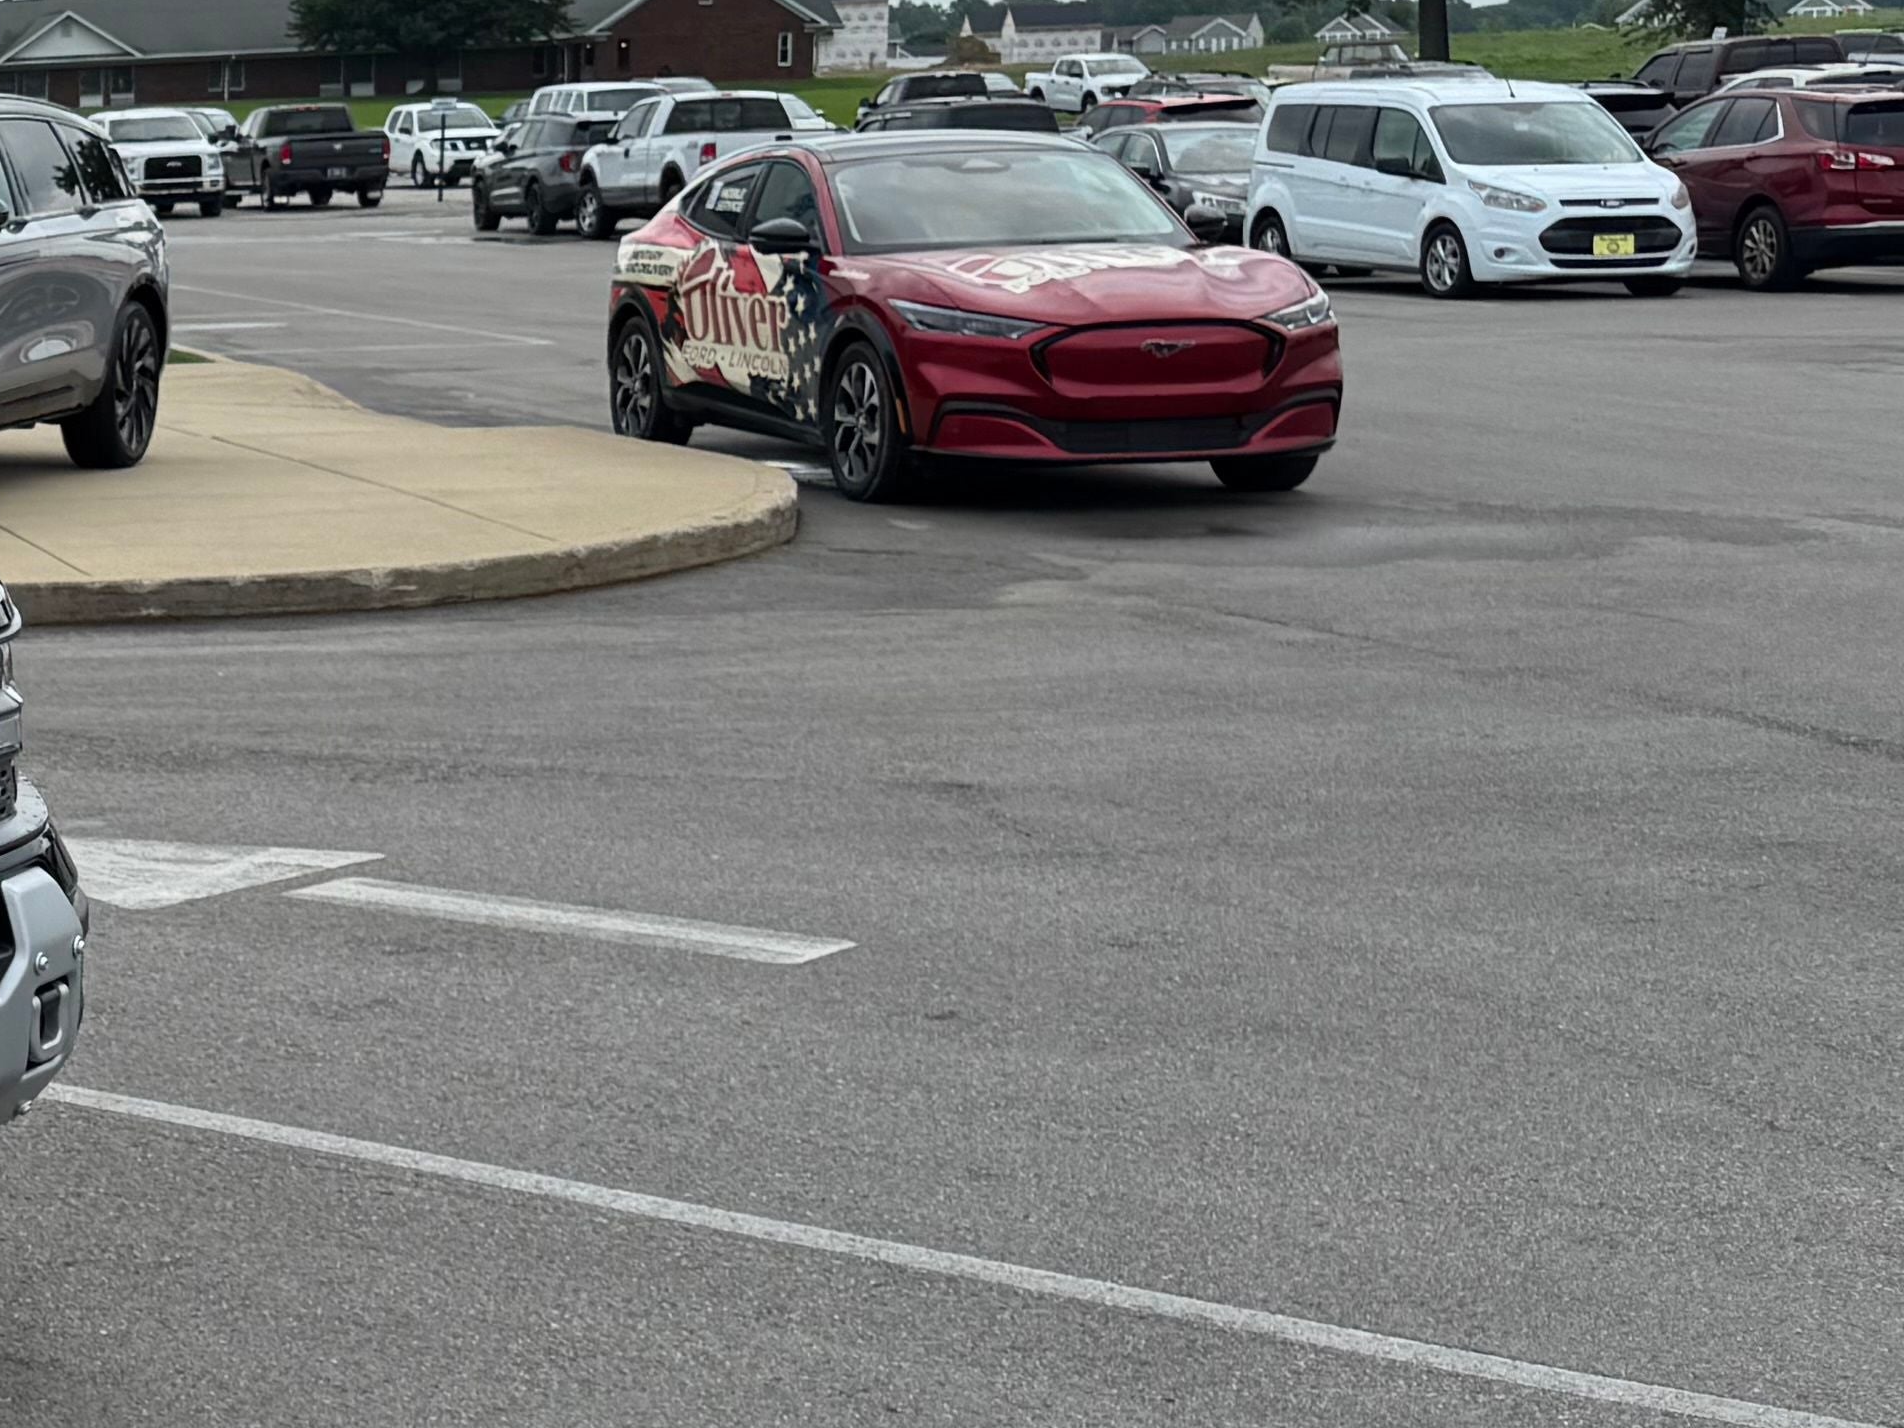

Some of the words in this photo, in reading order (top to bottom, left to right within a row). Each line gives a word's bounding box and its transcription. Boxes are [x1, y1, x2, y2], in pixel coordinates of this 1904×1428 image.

[680, 260, 789, 352] Oliver
[682, 343, 718, 369] FORD
[728, 348, 788, 376] LINCOLN
